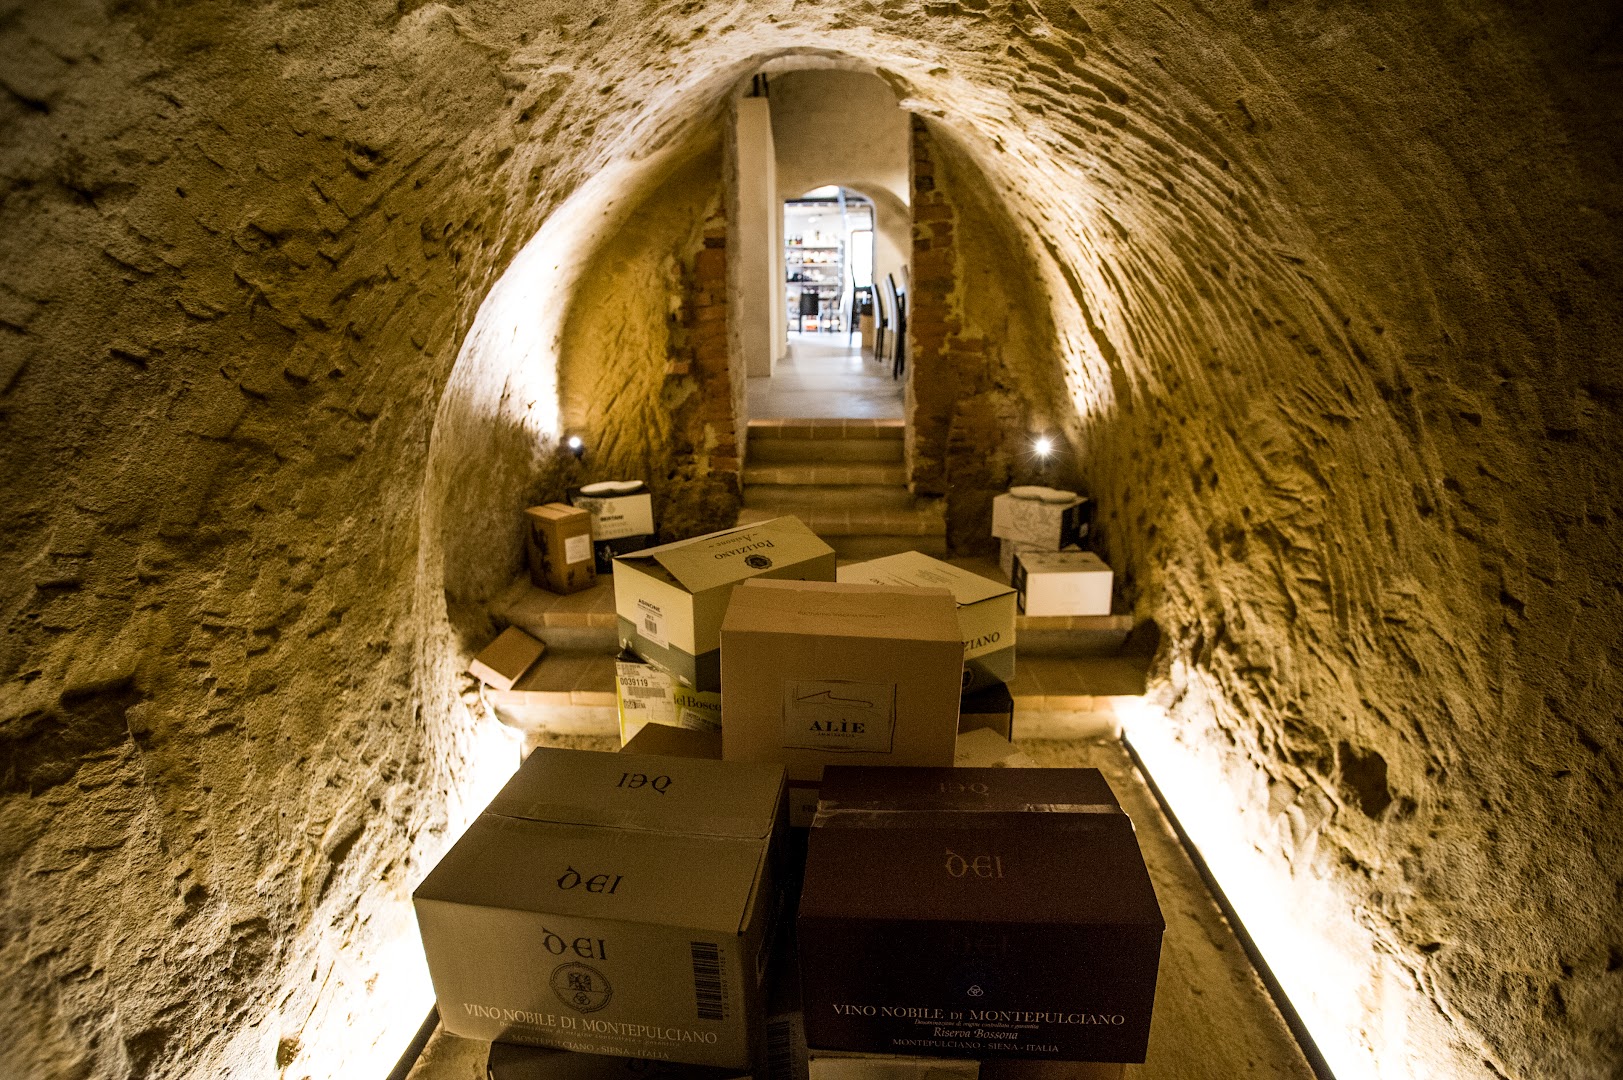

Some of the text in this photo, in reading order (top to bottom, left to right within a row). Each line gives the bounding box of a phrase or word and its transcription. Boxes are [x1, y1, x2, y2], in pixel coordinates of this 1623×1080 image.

[717, 534, 752, 548] Asinone
[620, 677, 648, 687] 0039119
[616, 773, 672, 795] DEI
[945, 848, 1004, 879] DEI
[557, 866, 623, 894] DEI
[542, 927, 607, 960] DEI
[463, 1003, 717, 1044] VINO NOBILE DI MONTEPULCIANO
[833, 1004, 876, 1017] VINO
[881, 1006, 944, 1019] NOBILE
[970, 1009, 1125, 1026] MONTEPULCIANO
[933, 1026, 1018, 1040] Riserva Bossona
[511, 1034, 595, 1051] MONTEPULCIANO
[601, 1045, 630, 1055] SIENA
[638, 1050, 669, 1060] ITALIA
[892, 1038, 981, 1049] MONTEPULCIANO
[988, 1042, 1018, 1051] SIENA
[1026, 1044, 1059, 1053] ITALIA
